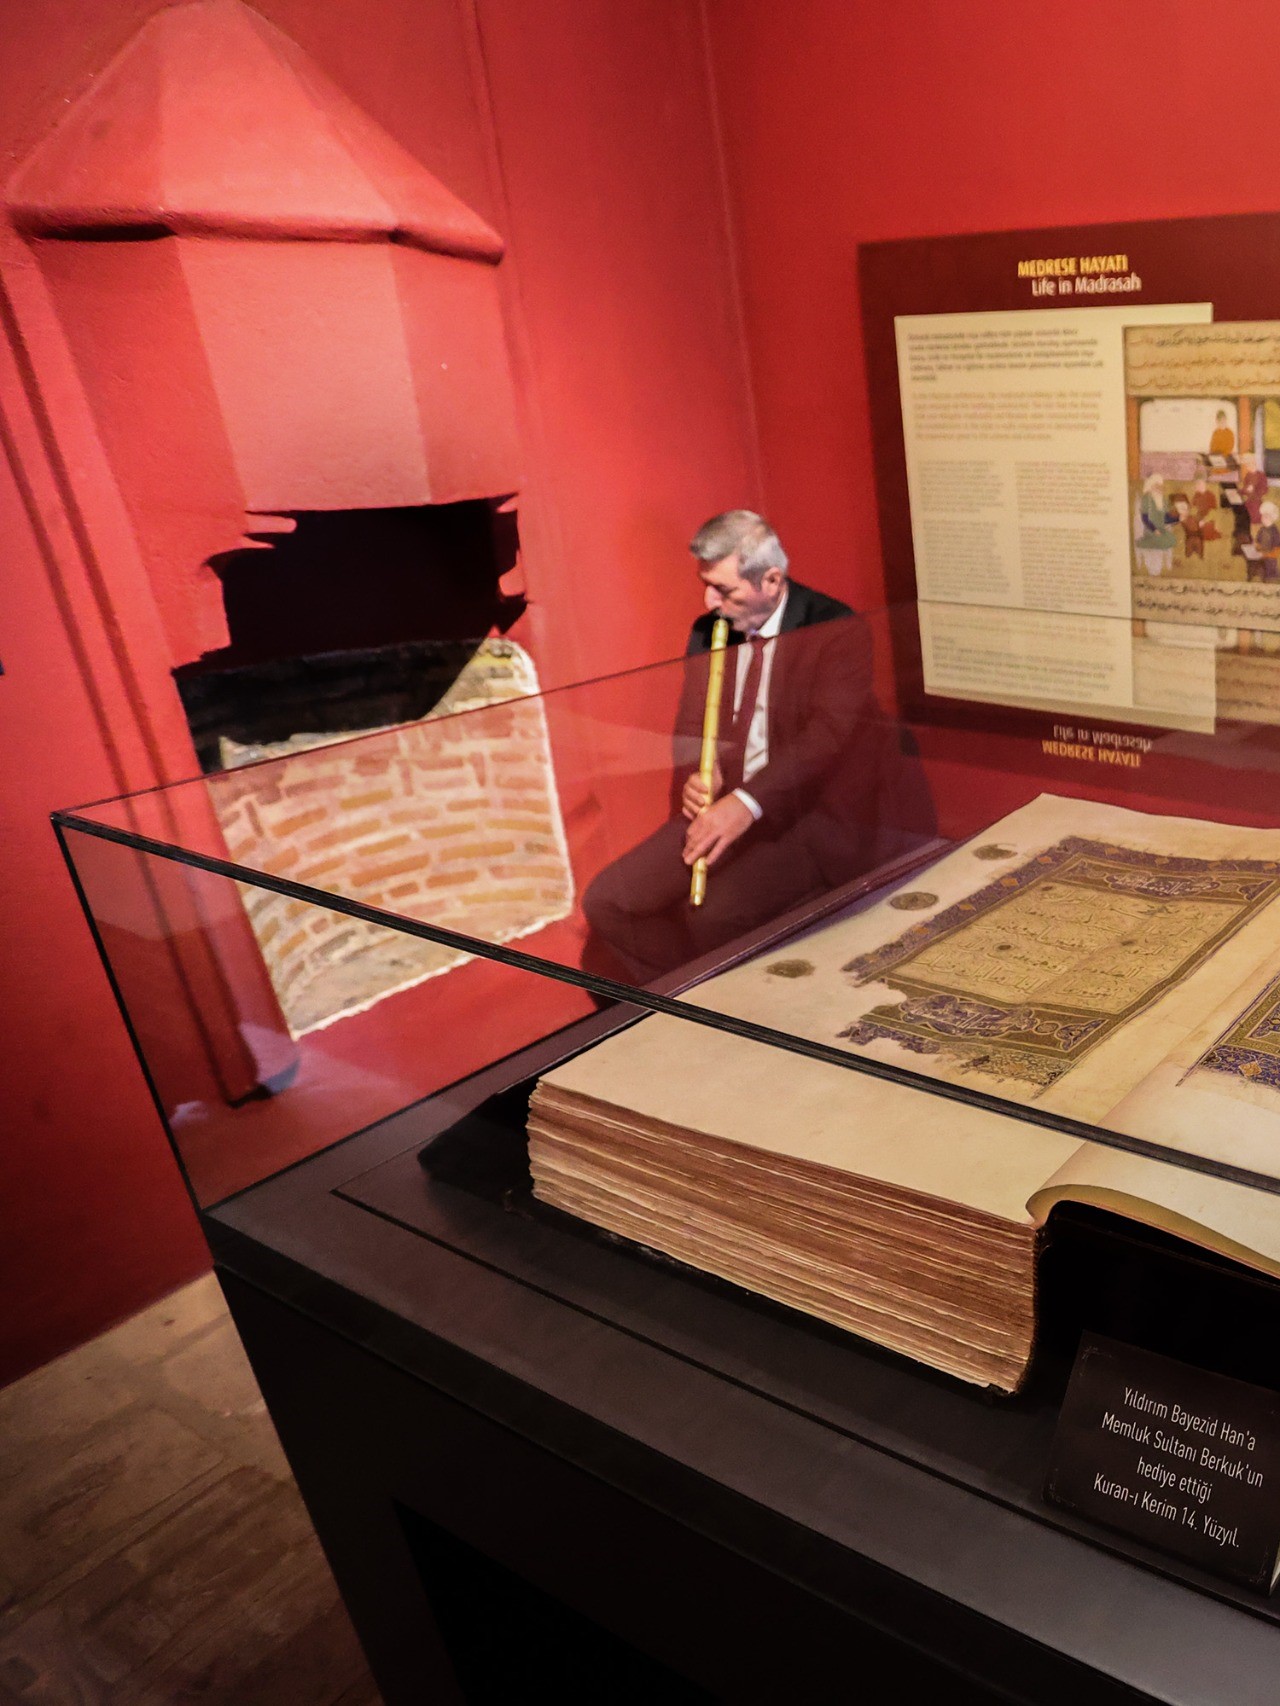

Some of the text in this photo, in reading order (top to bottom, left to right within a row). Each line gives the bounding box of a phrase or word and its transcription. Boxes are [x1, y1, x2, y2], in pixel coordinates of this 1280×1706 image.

[1018, 254, 1129, 277] MEDRESE HAYATI
[1032, 272, 1142, 297] Life in Madrasah
[1124, 1387, 1256, 1451] Yıldırım Bayezid Han'a
[1101, 1411, 1264, 1488] Memluk Sultanı Berkuk'un
[1136, 1456, 1213, 1504] hediye ettiği
[1093, 1472, 1240, 1548] Kuran-ı Kerim 14. Yüzyıl.
